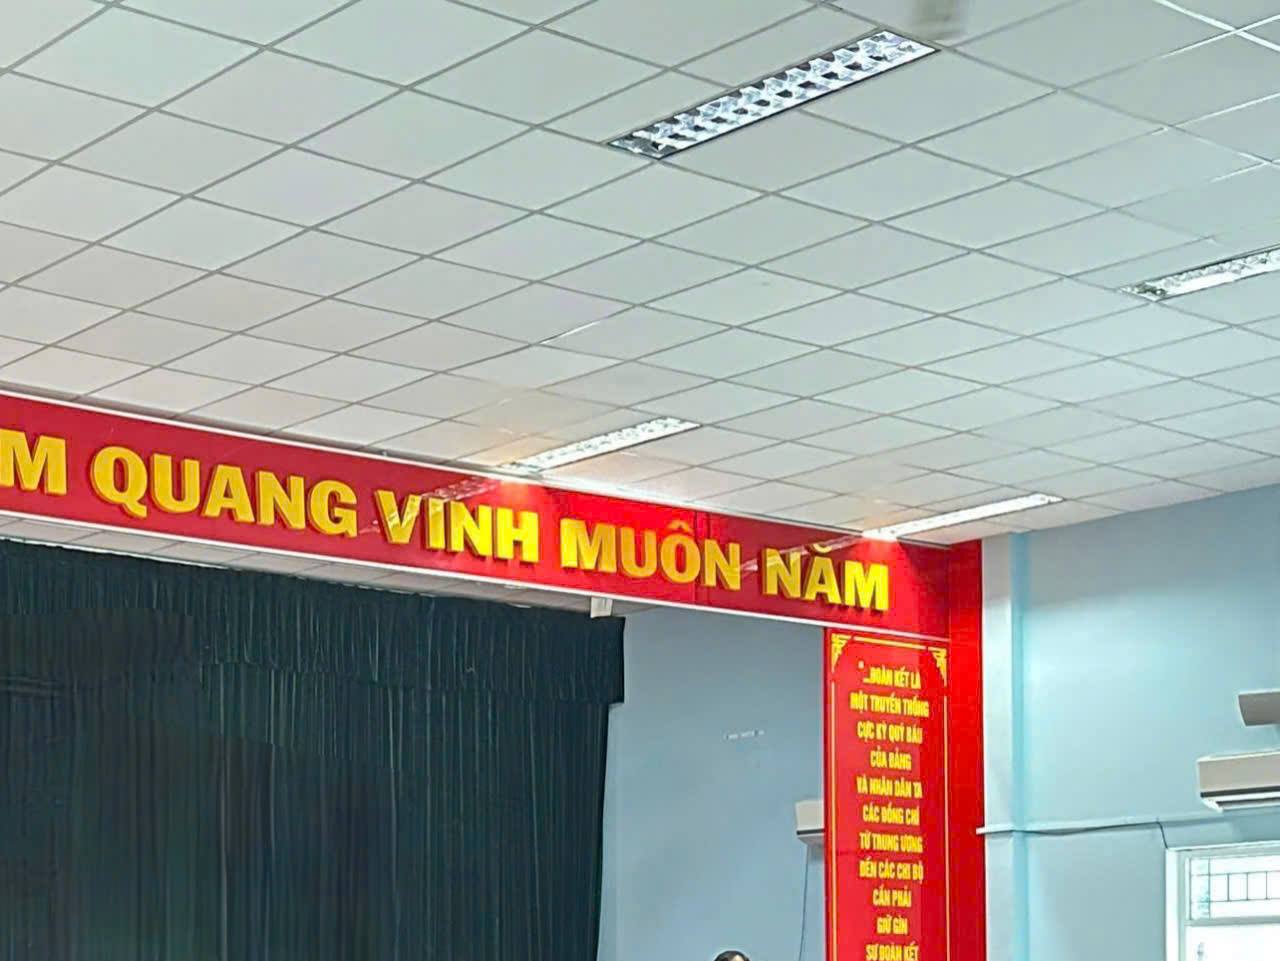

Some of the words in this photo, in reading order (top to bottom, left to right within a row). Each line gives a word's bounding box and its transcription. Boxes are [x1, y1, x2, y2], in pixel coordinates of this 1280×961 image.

[90, 446, 358, 538] QUANG
[374, 488, 540, 563] VINH
[559, 518, 741, 591] MUÔN
[761, 543, 889, 611] NĂM
[850, 690, 869, 714] MỘT
[870, 745, 888, 769] CỦA
[888, 746, 913, 772] ĐẢNG
[856, 773, 869, 795] VÀ
[862, 801, 881, 824] CÁC
[905, 805, 920, 827] CHÍ
[872, 832, 900, 852] TRUNG
[878, 858, 896, 880] CÁC
